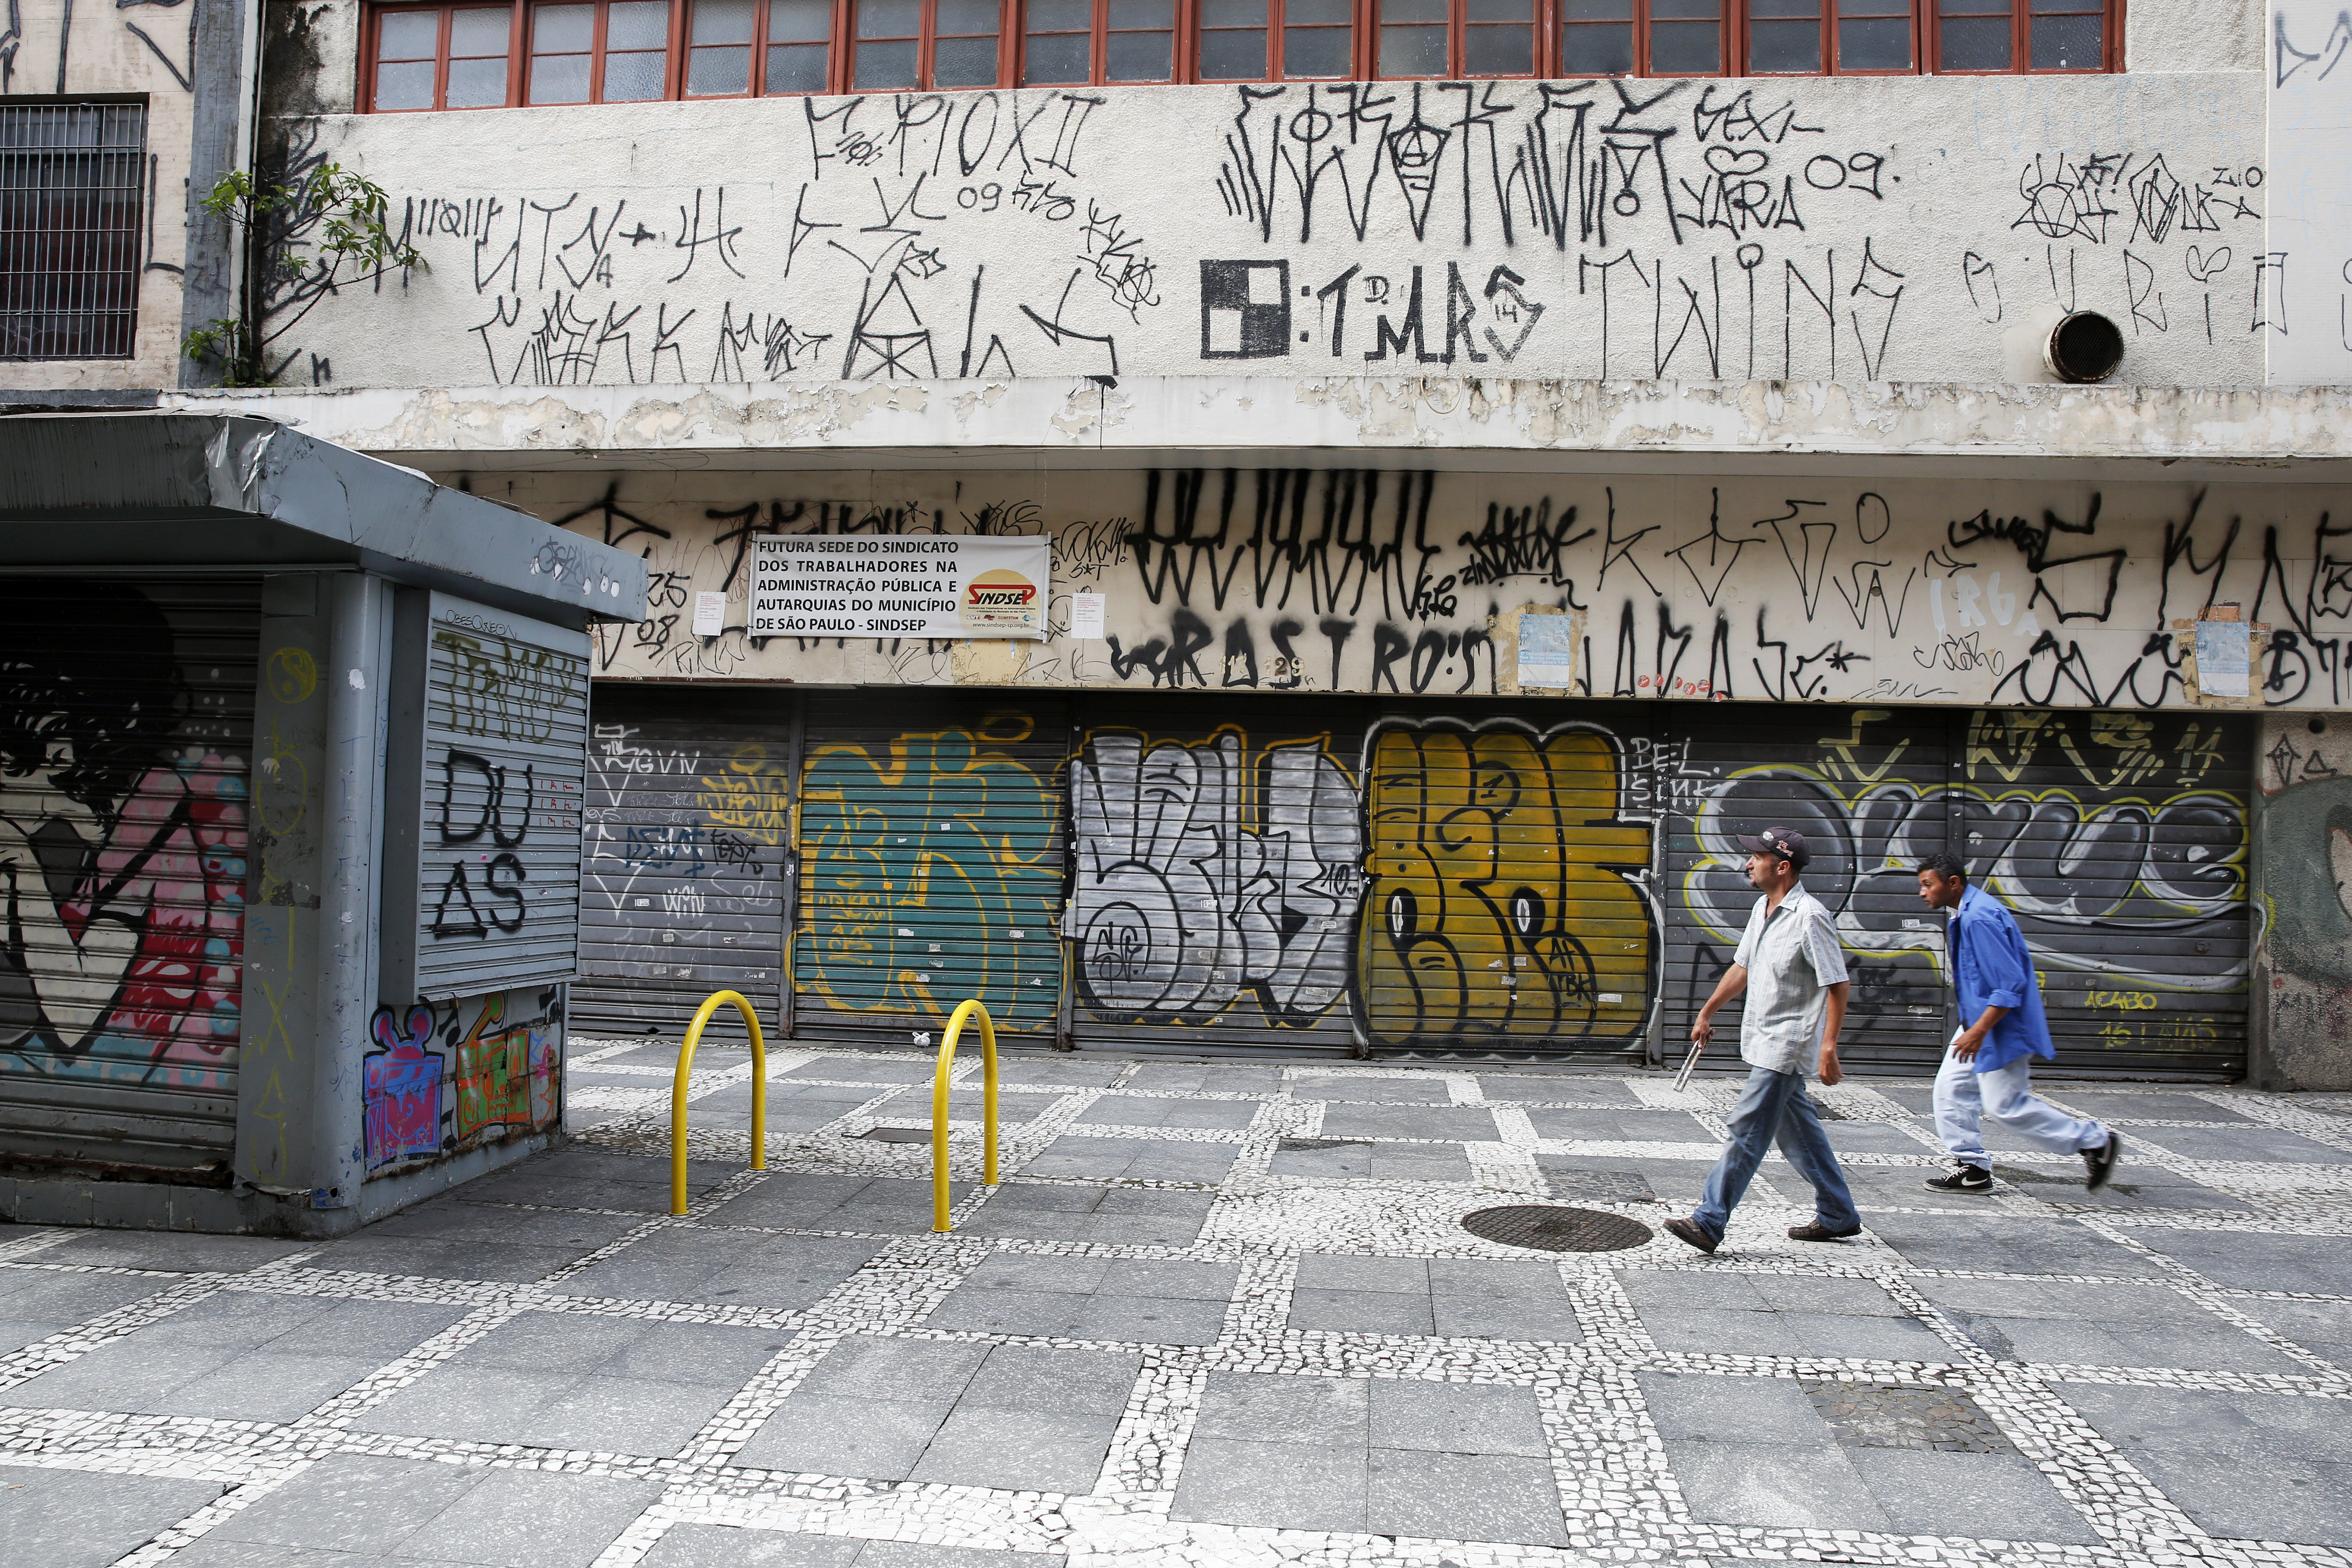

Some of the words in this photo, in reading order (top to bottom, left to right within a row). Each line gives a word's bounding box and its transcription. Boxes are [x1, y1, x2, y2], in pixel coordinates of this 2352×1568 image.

[759, 541, 815, 553] FUTURA
[818, 541, 854, 553] SEDE
[857, 541, 879, 553] DO
[882, 541, 959, 553] SINDICATO
[758, 560, 789, 572] DOS
[797, 560, 928, 573] TRABALHADORES
[936, 561, 958, 573] NA
[757, 578, 875, 594] ADMINISTRAÇÃO
[882, 578, 942, 592] PÚBLICA
[949, 581, 957, 592] E
[968, 584, 1036, 605] SINDSEP
[756, 599, 846, 612] AUTARQUIAS
[851, 599, 873, 611] DO
[878, 597, 956, 612] MUNICÍPIO
[756, 618, 774, 629] DE
[778, 616, 806, 630] SÃO
[809, 619, 855, 630] PAULO
[866, 620, 927, 631] SINDSEP
